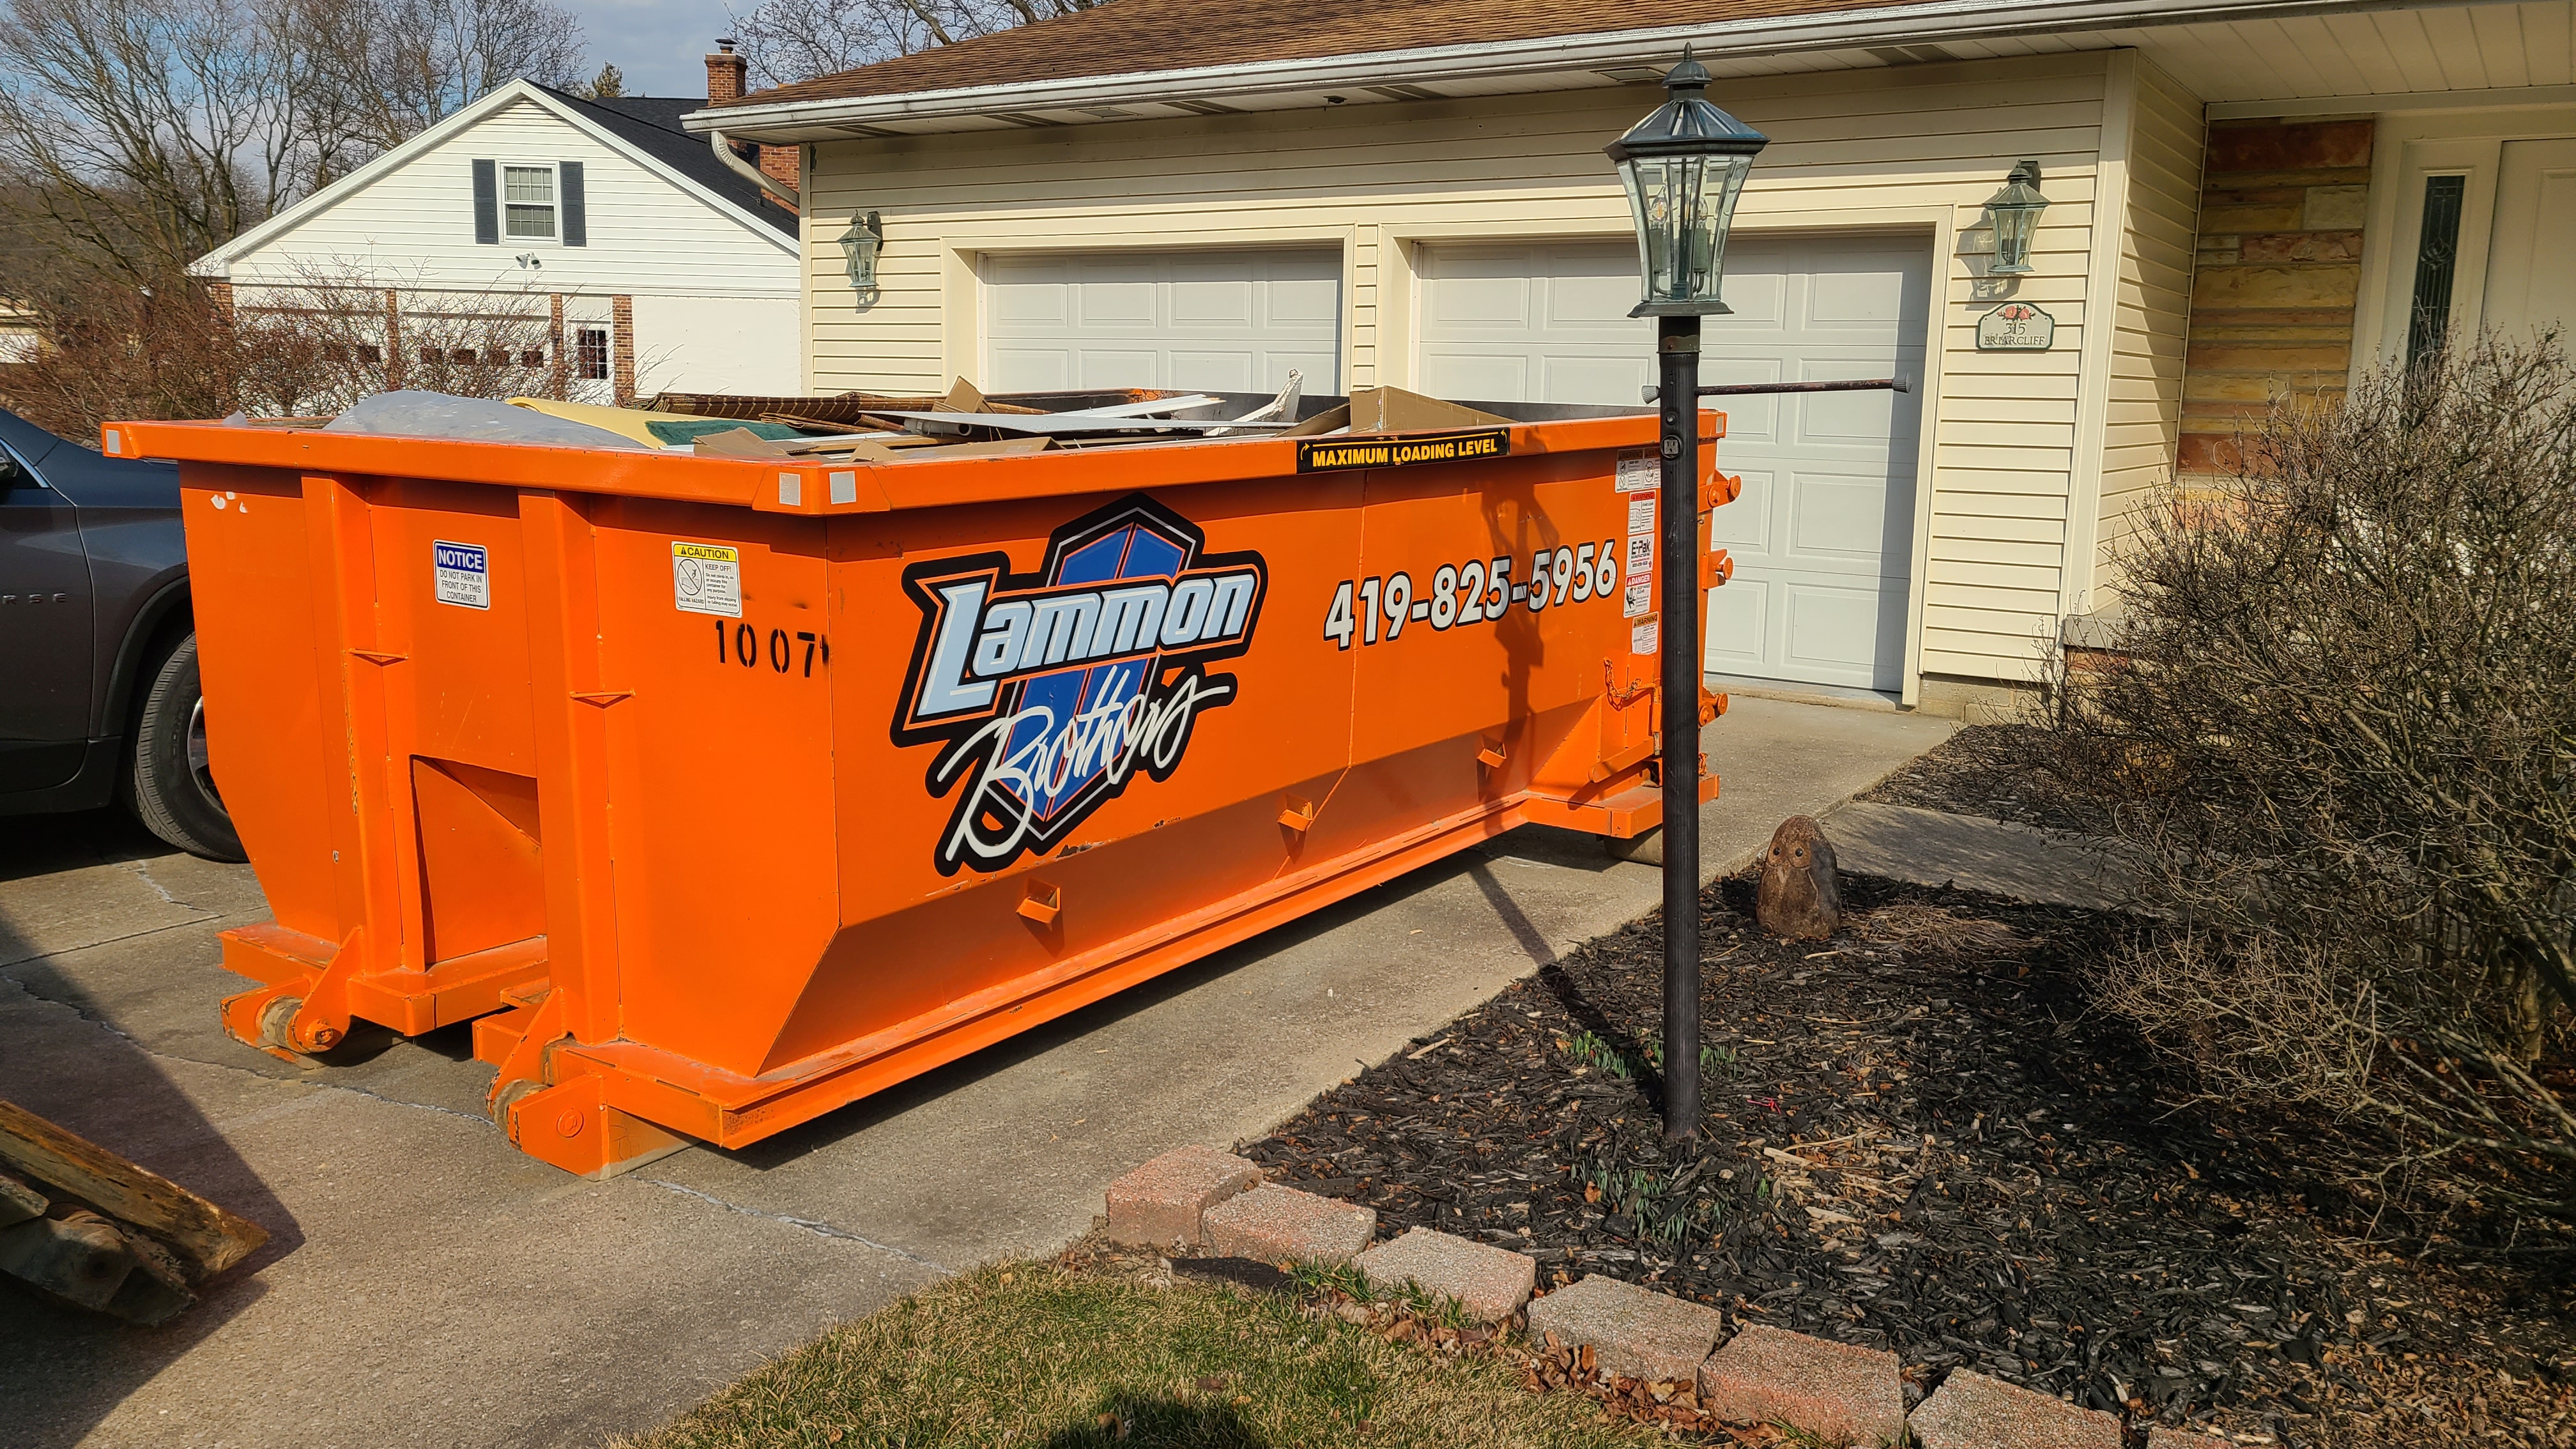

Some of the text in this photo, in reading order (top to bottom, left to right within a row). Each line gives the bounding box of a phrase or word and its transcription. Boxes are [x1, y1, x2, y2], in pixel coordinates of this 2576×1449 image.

[2003, 322, 2027, 335] 315
[1983, 335, 2045, 346] BRIARCLIFF
[1312, 438, 1498, 467] MAXIMUM LOADING LEVEL
[687, 547, 729, 560] CAUTION
[1631, 539, 1650, 555] E-Pak
[438, 549, 483, 570] NOTICE
[440, 569, 482, 583] DO NOT PARK IN
[1631, 574, 1650, 585] DANGER
[441, 579, 481, 594] FRONT OF THIS
[446, 590, 477, 603] CONTAINER
[1324, 539, 1618, 651] 419-825-5956
[915, 573, 1256, 717] Lammon
[937, 665, 1229, 862] Brothers
